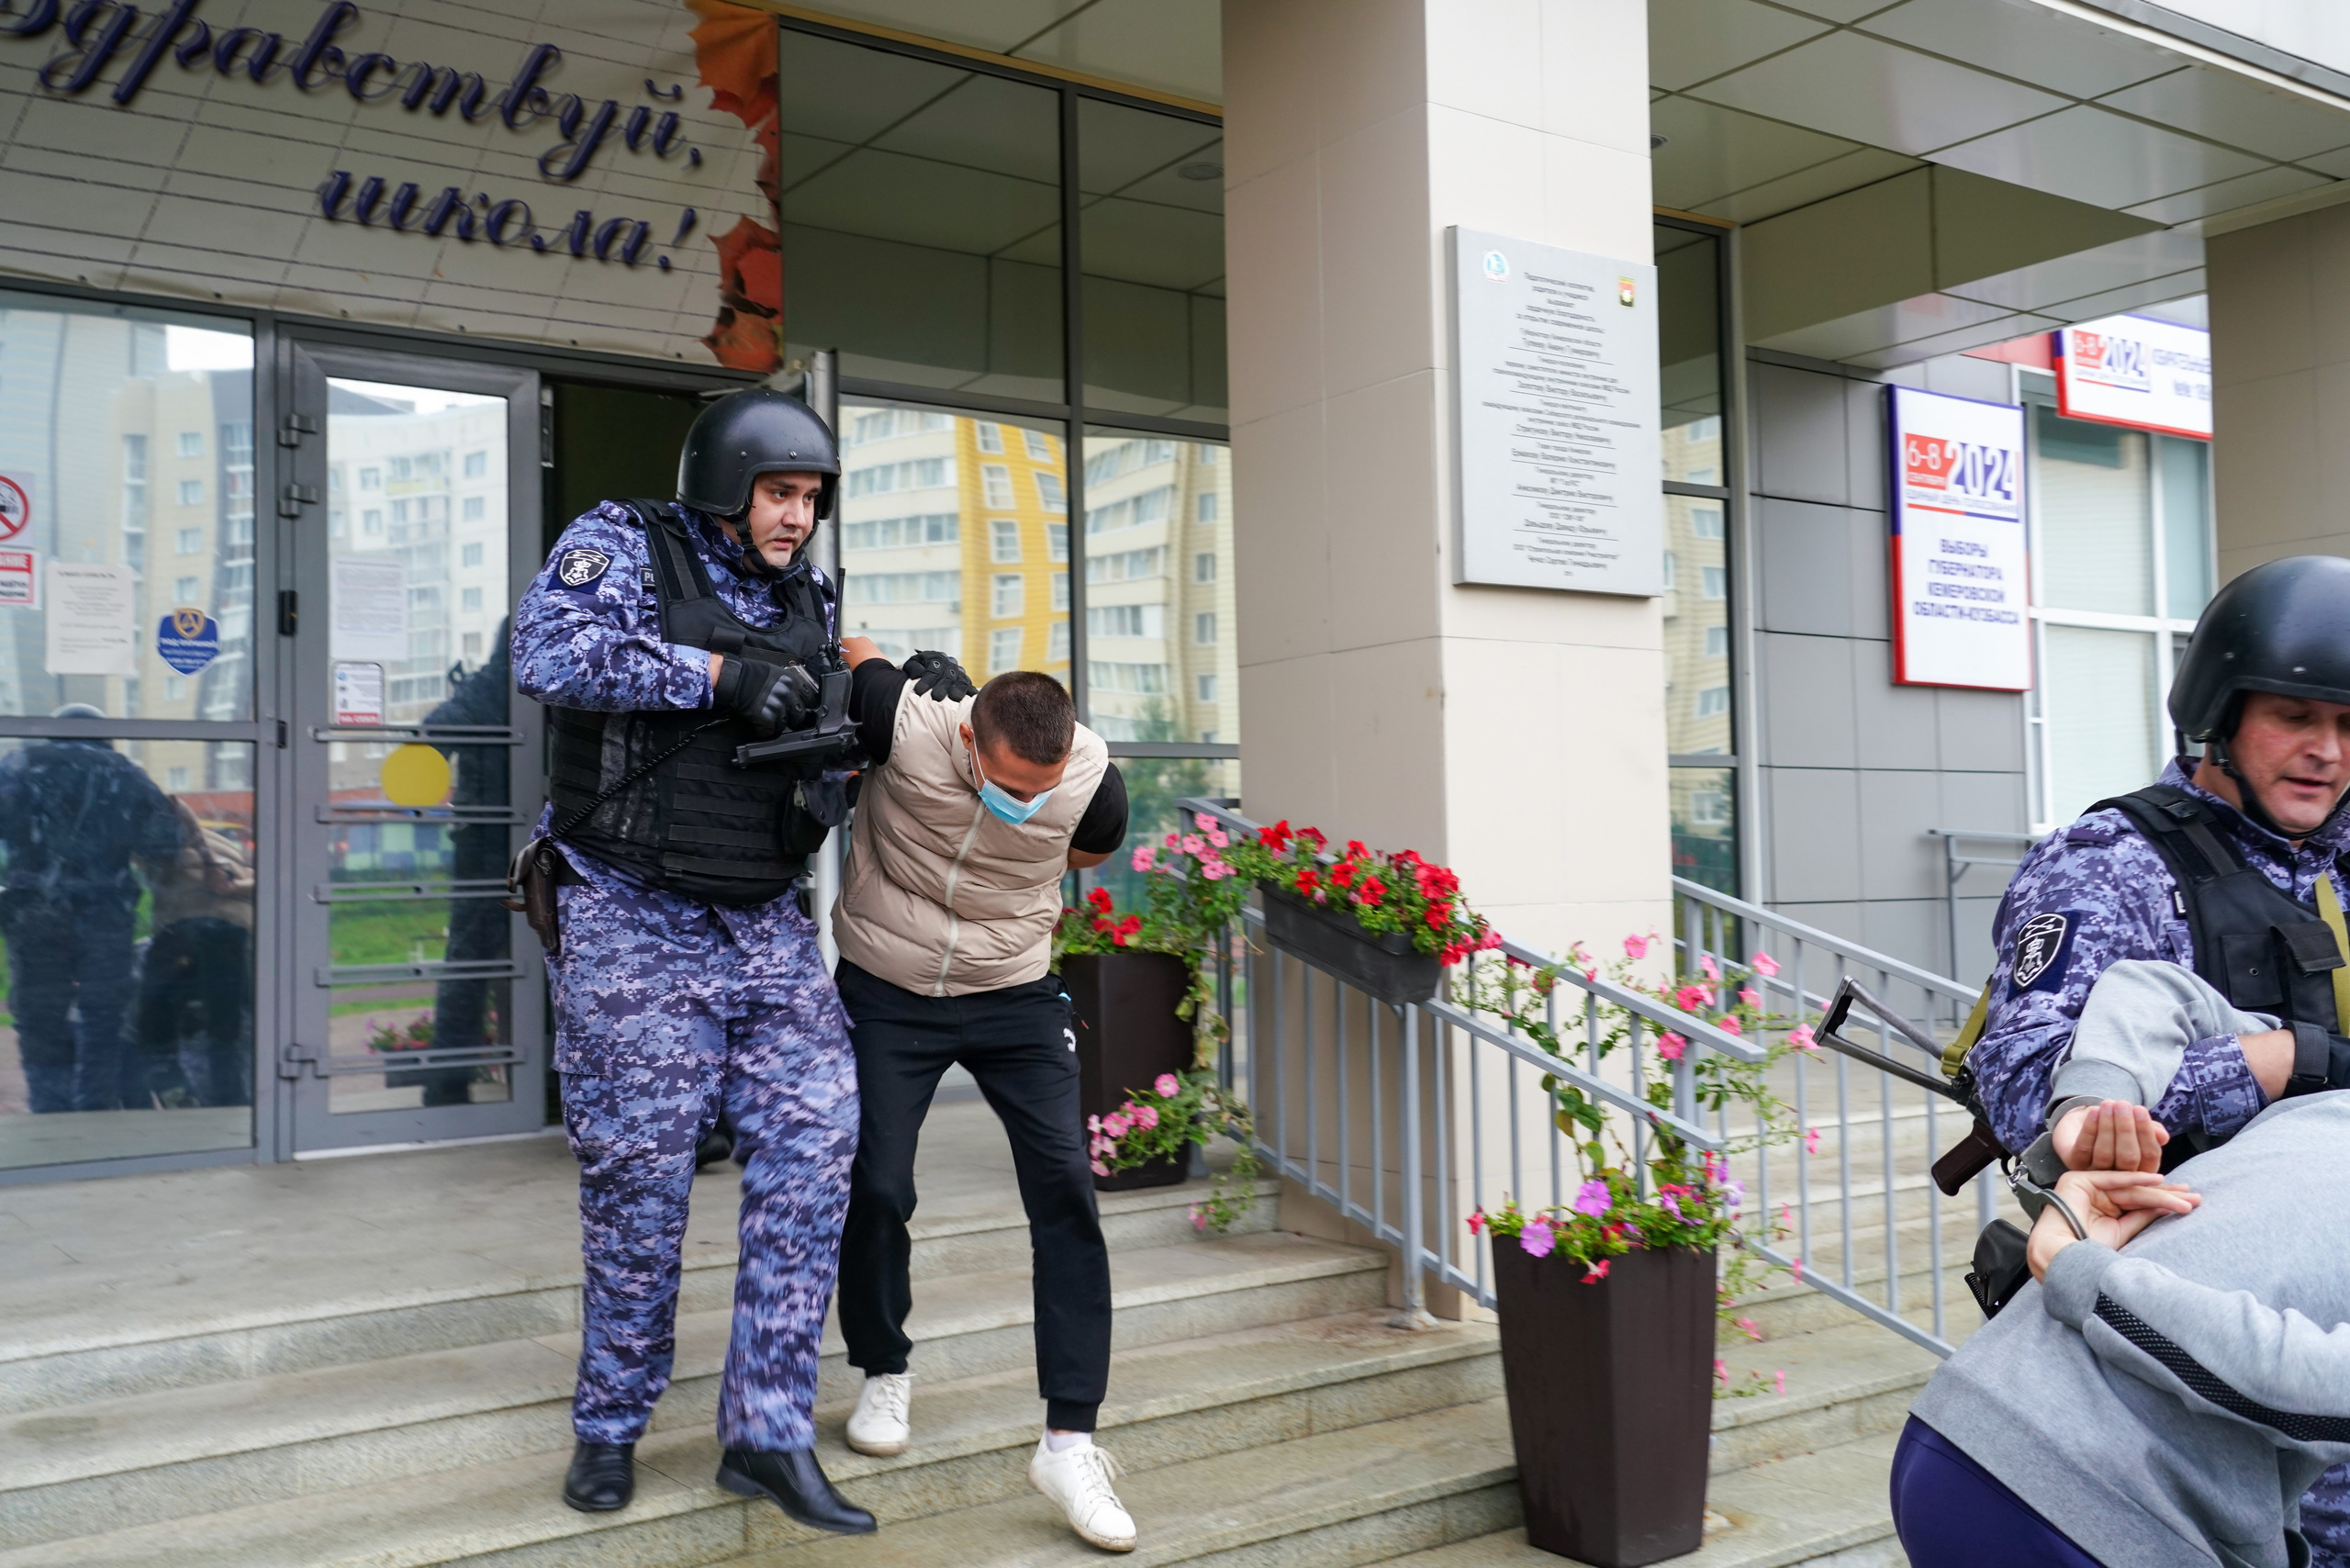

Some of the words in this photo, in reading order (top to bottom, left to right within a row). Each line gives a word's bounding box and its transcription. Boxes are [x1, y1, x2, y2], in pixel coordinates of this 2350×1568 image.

[318, 169, 698, 271] школа!
[1907, 440, 1942, 470] 6-8
[1944, 440, 2016, 504] 2024
[1940, 538, 1988, 558] ВЫБОРЫ
[1927, 558, 2004, 581] ГУБЕРНАТОРА
[1927, 581, 2006, 604] КЕМЕРОВСКОЙ
